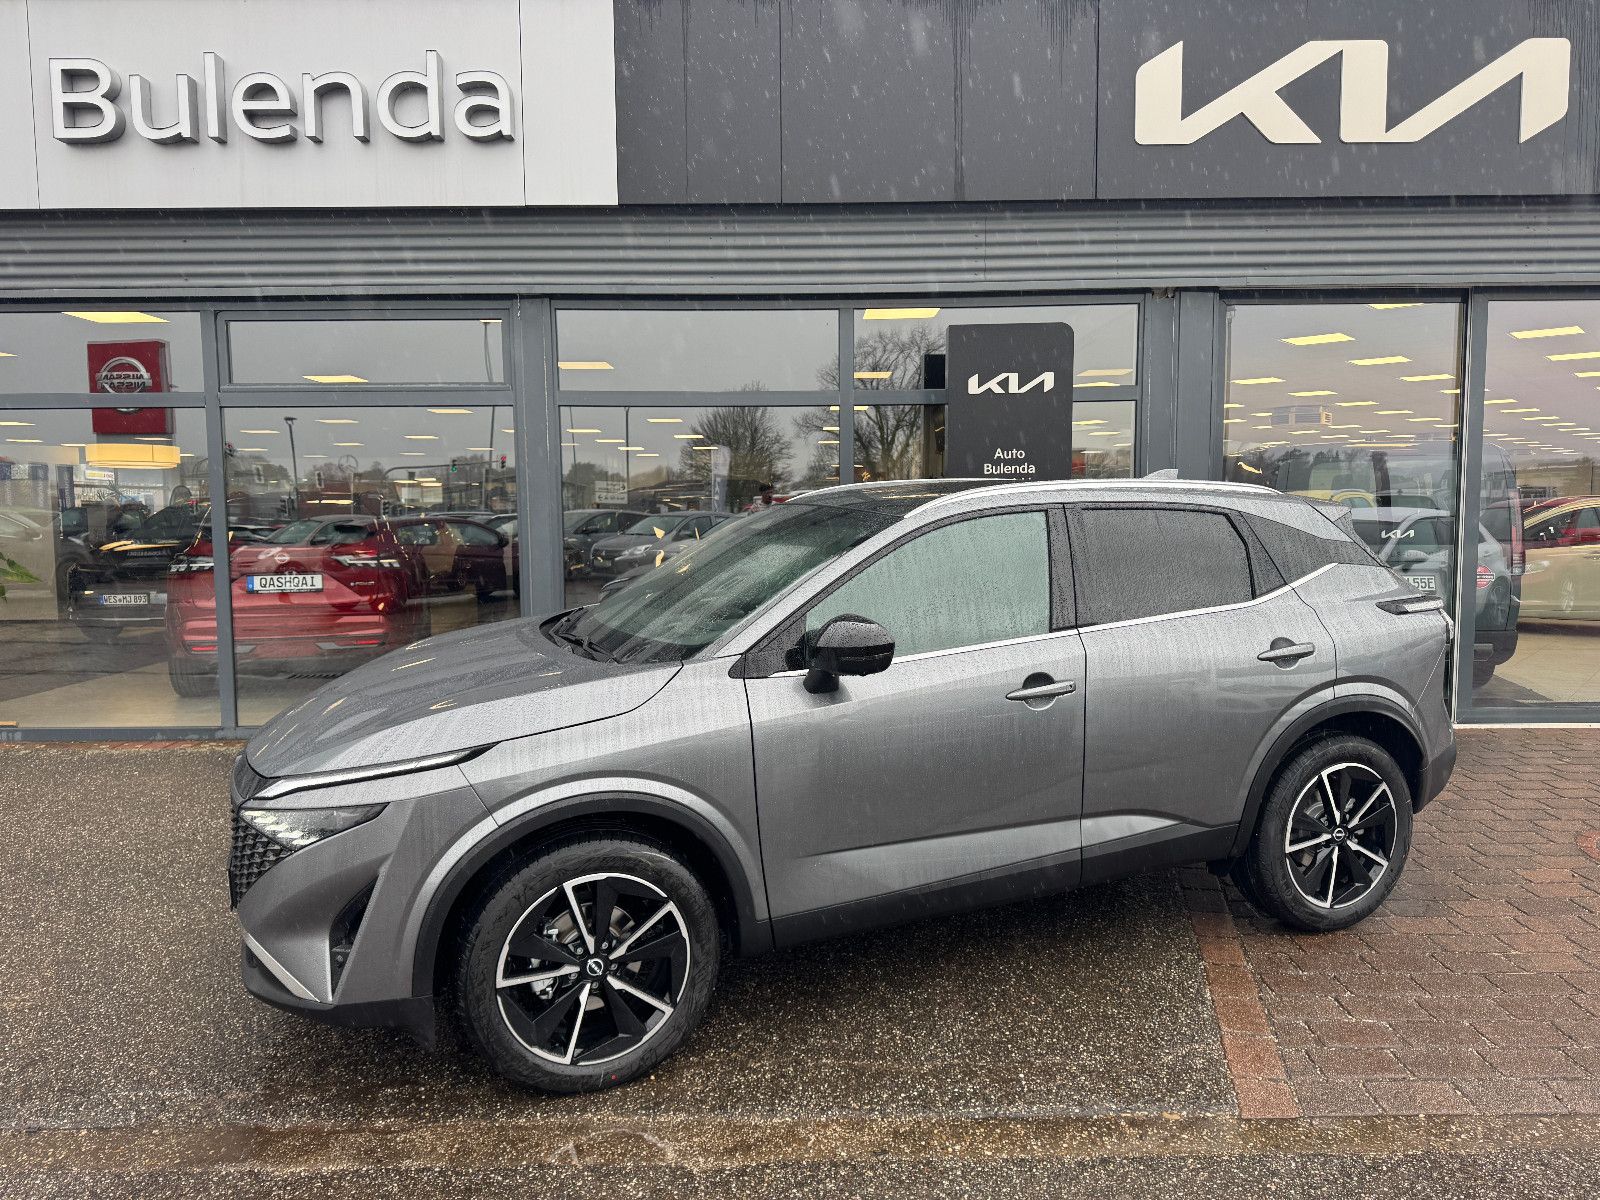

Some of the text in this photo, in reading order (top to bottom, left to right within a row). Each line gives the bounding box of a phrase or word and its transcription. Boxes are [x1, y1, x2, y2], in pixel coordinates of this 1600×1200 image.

[1135, 37, 1571, 145] KIA
[49, 50, 515, 145] Bulenda
[967, 371, 1055, 395] KIA
[993, 448, 1026, 460] Auto
[983, 462, 1036, 474] Bulenda
[1381, 529, 1415, 539] KIA
[259, 576, 317, 588] QASHQAI
